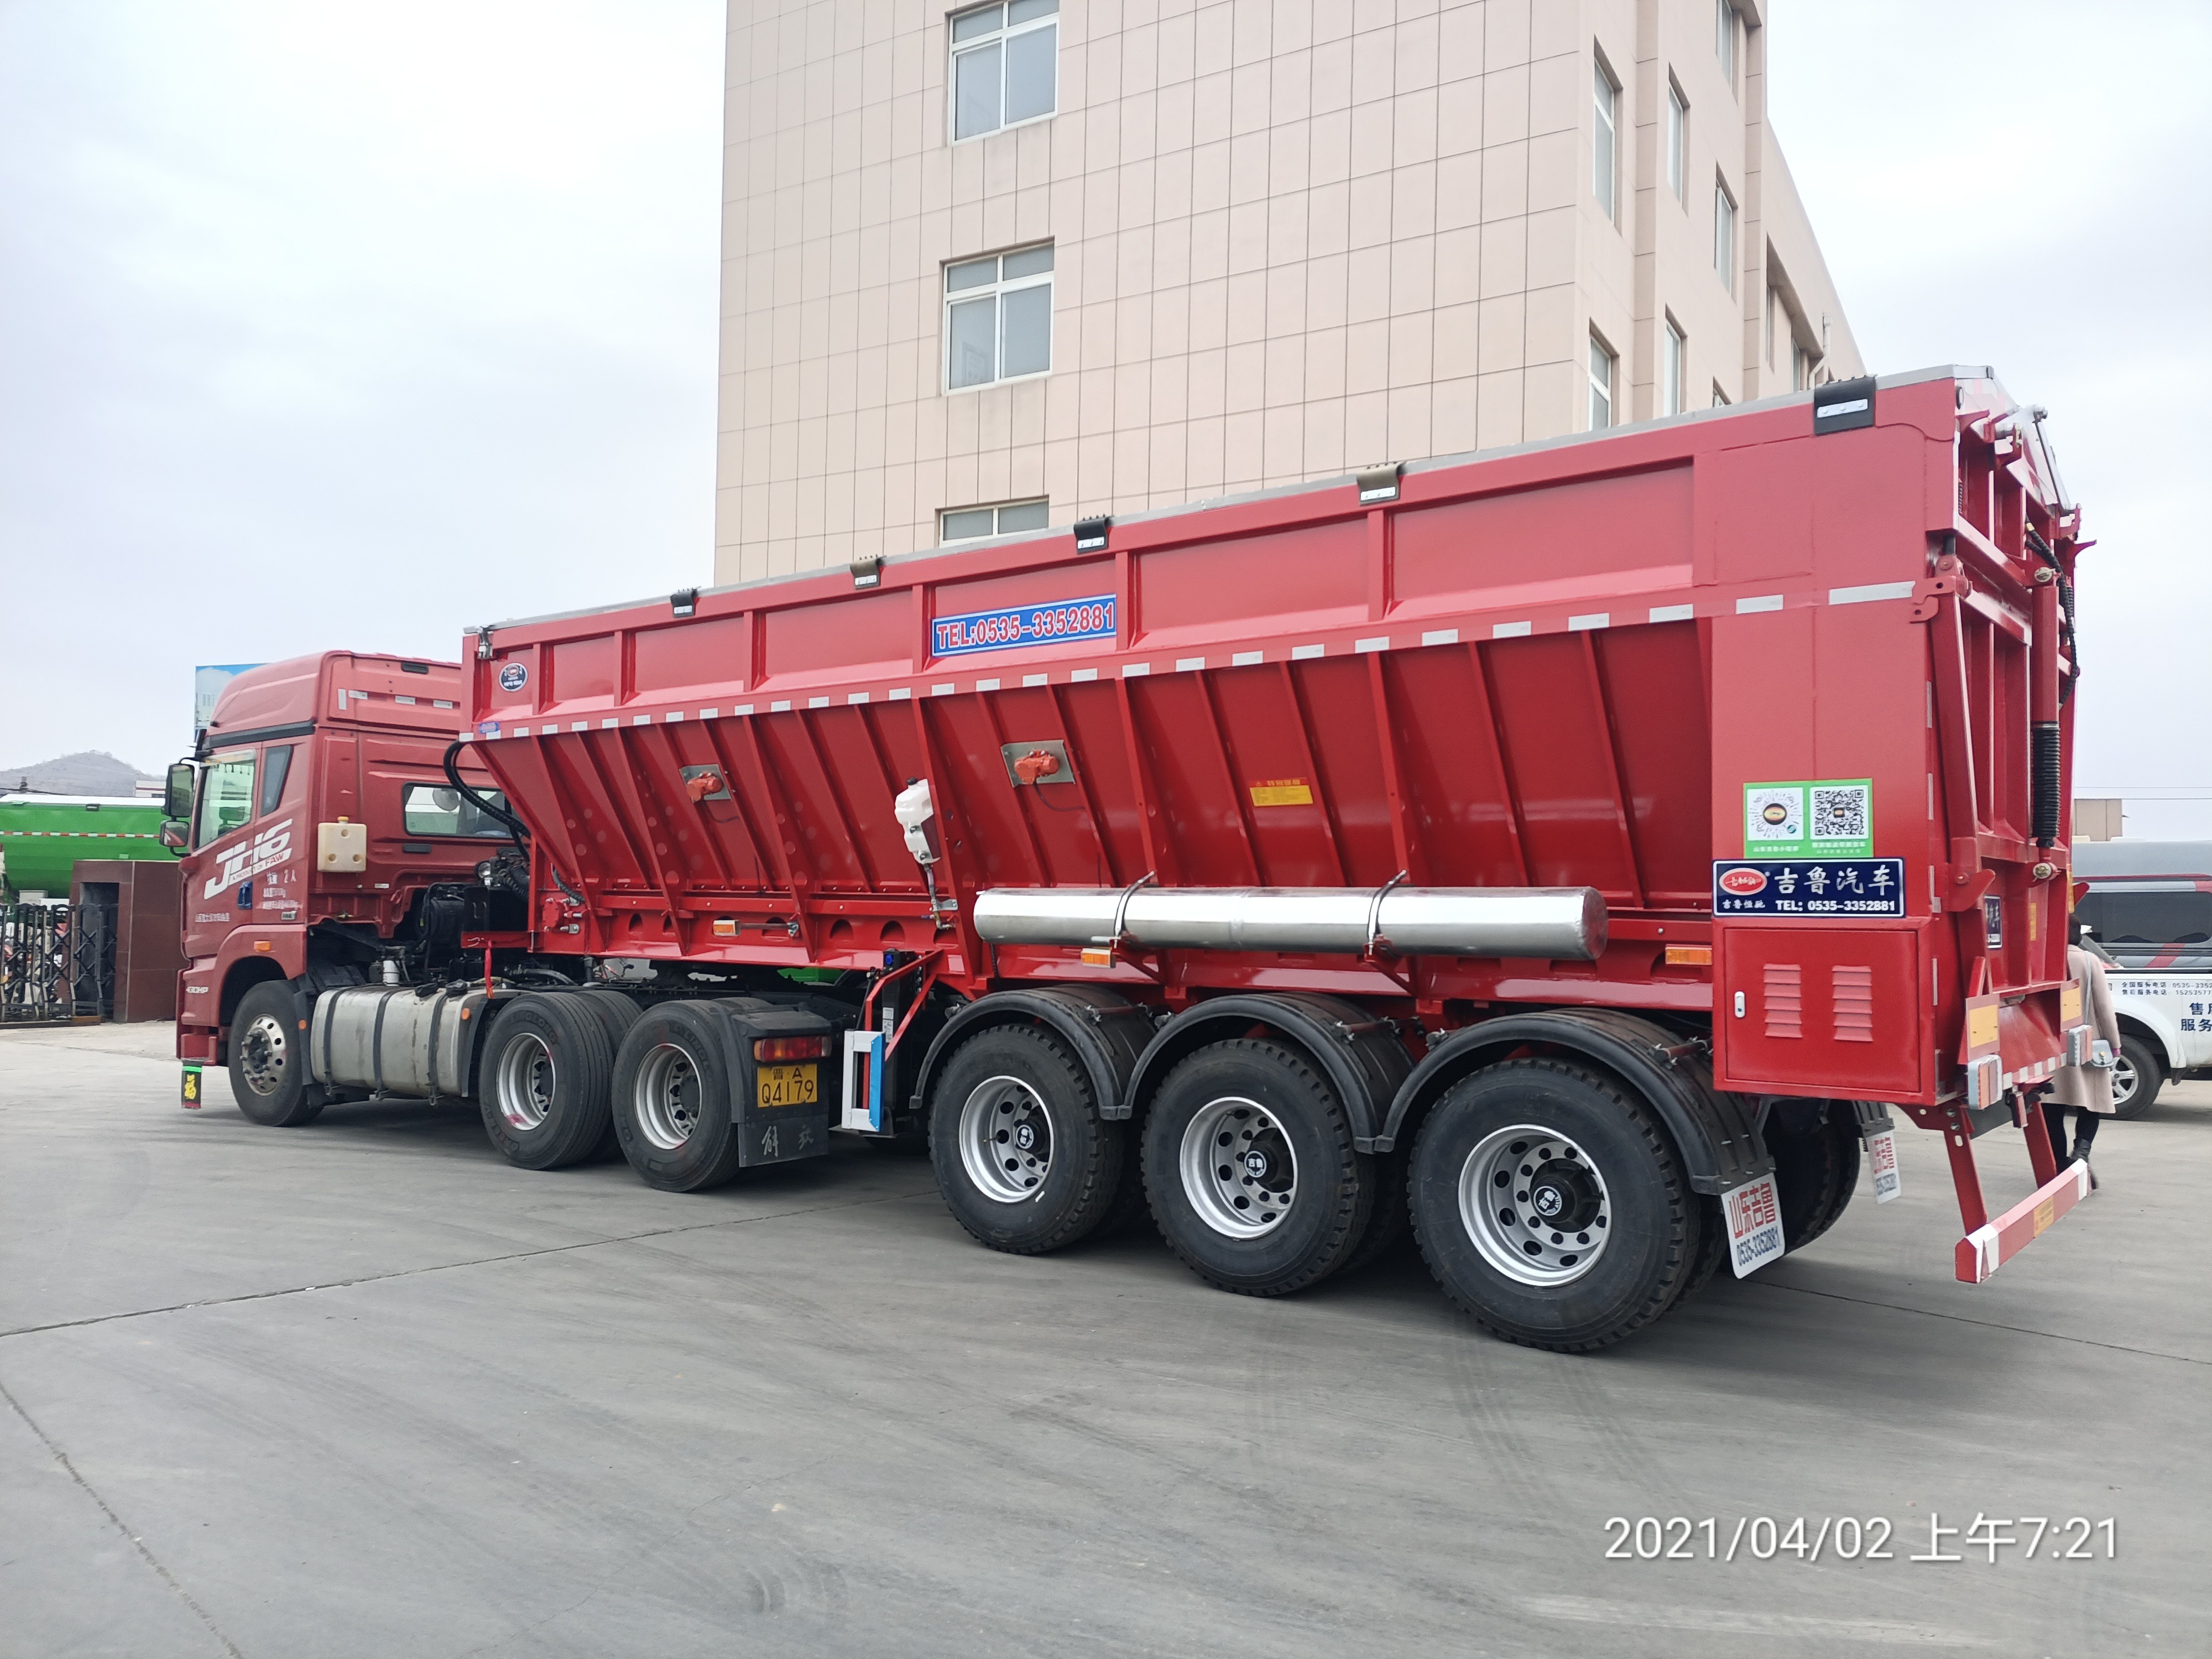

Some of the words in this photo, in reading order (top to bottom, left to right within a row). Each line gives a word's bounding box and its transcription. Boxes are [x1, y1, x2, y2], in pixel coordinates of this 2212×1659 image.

[936, 602, 1114, 650] TEL:0535-3352881
[204, 818, 293, 900] JH6
[265, 852, 284, 867] FAW
[1774, 864, 1895, 896] 吉鲁汽车
[1775, 900, 1803, 911] TEL:
[1807, 900, 1895, 911] 0535-3352881
[2180, 1018, 2212, 1032] 服务
[761, 1079, 815, 1104] Q4179
